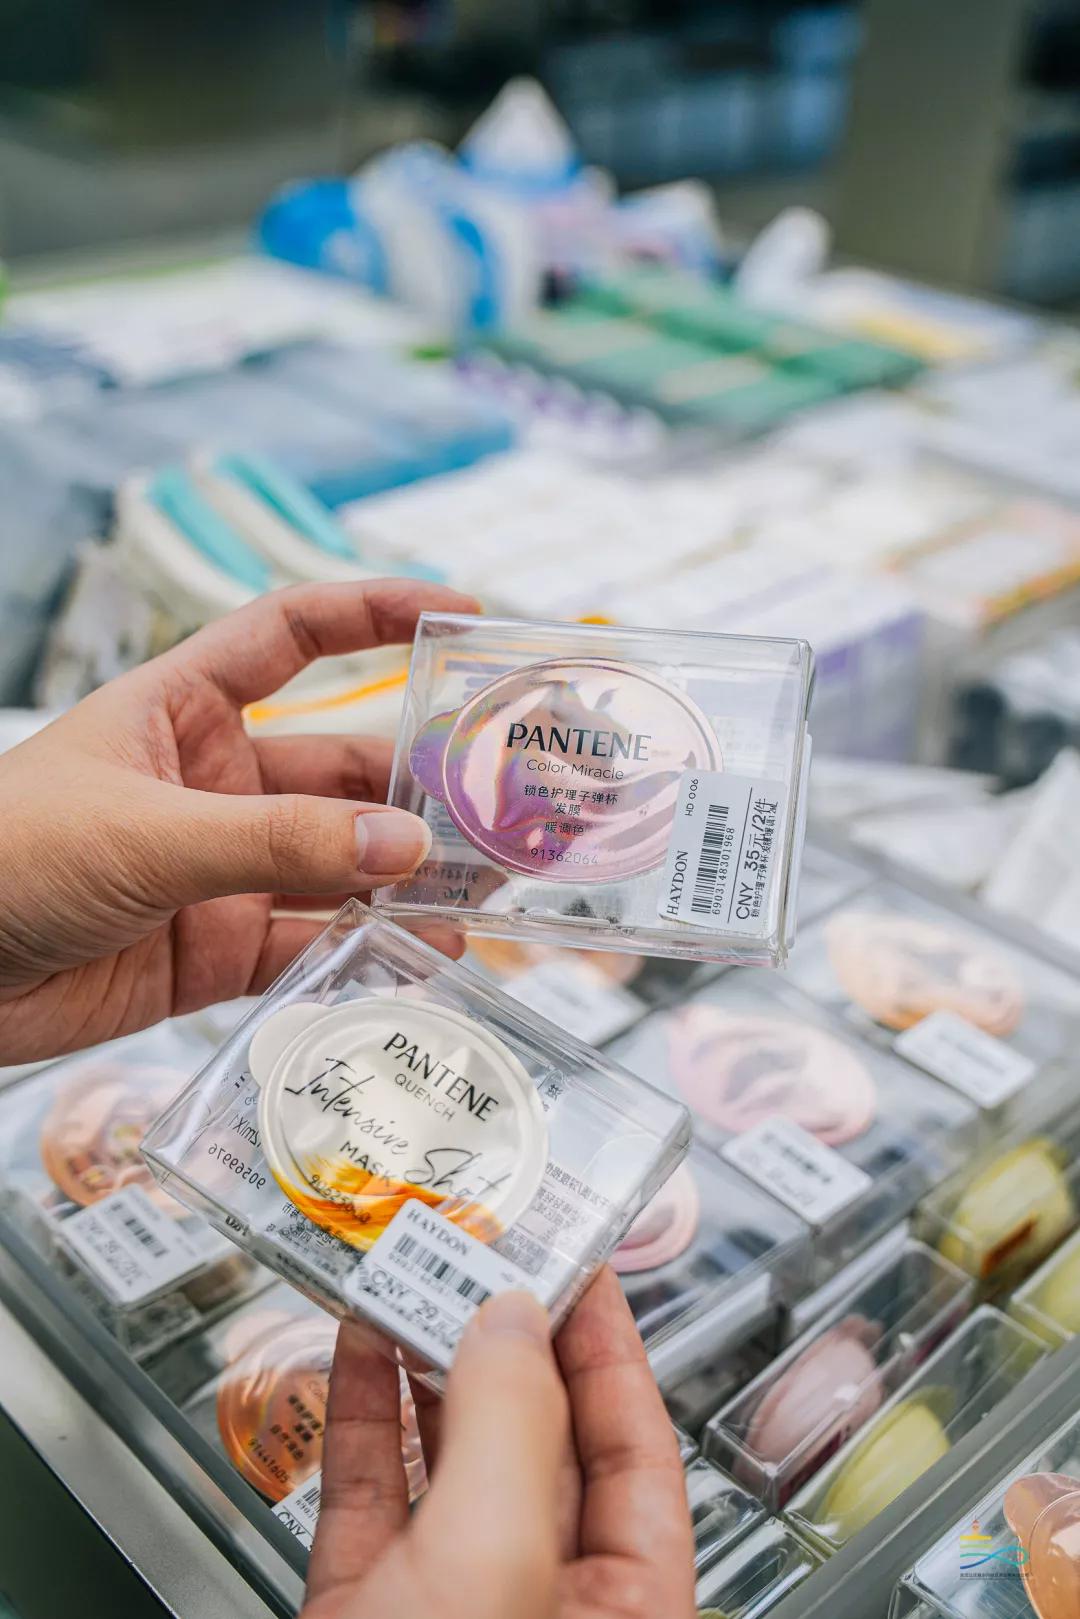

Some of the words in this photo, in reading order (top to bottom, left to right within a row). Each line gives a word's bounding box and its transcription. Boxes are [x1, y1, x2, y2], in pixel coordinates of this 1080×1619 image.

[506, 722, 652, 762] PANTENE
[526, 758, 567, 774] Color
[570, 763, 624, 780] Miracle
[524, 784, 619, 806] 锁色护理子弹杯
[554, 802, 582, 817] 发膜
[684, 803, 695, 817] HD
[544, 821, 585, 837] 暖调色
[530, 847, 599, 865] 91362064
[711, 827, 735, 915] 6903148301968
[666, 850, 689, 916] HAYDON
[736, 881, 754, 920] CNY
[383, 1032, 499, 1122] PANTENE
[394, 1073, 456, 1122] QUENCH
[285, 1057, 409, 1155] Intensive
[403, 1147, 512, 1200] Shot
[339, 1140, 398, 1187] MASK
[406, 1207, 473, 1257] HAYDON
[371, 1269, 411, 1297] CNY
[277, 1510, 307, 1536] CNY
